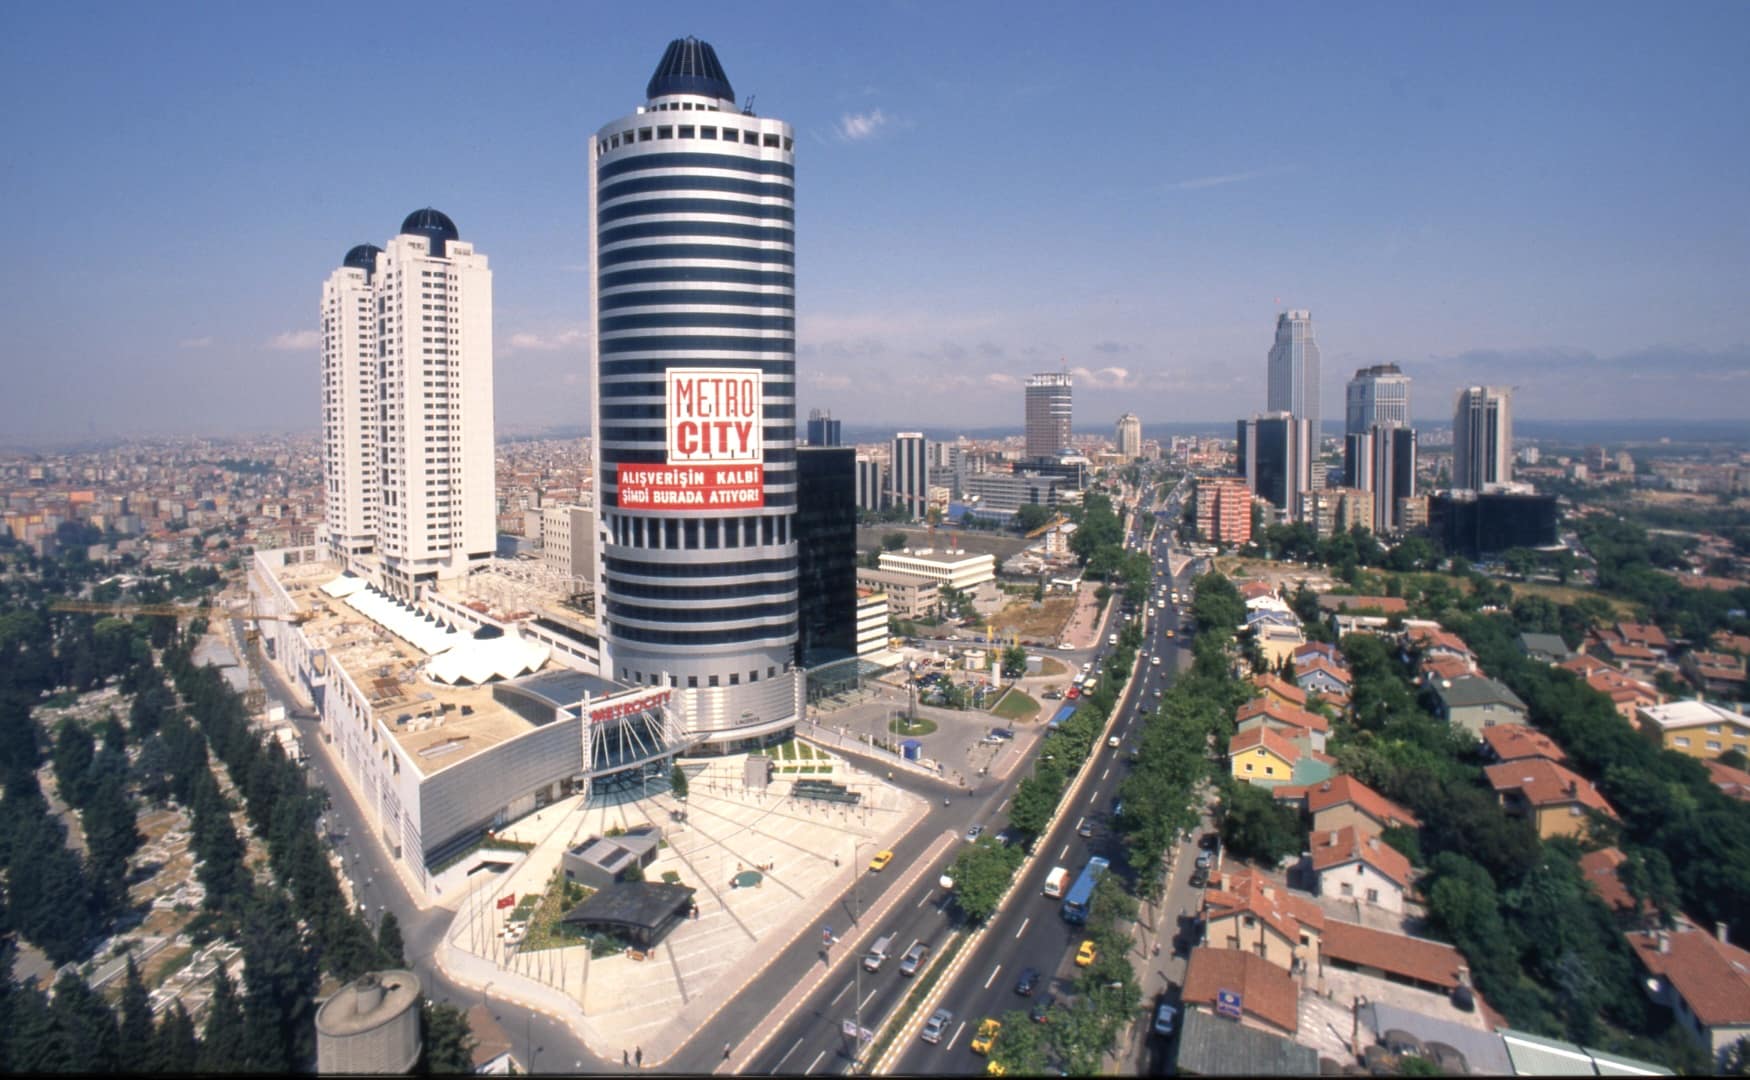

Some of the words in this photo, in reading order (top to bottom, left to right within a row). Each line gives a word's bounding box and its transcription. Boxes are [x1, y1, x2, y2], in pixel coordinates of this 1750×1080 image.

[676, 378, 753, 417] METRO
[677, 421, 752, 454] CITY
[622, 469, 704, 488] ALIŞVERİŞİN
[717, 469, 758, 485] KALBİ
[622, 488, 649, 504] ŞİMDİ
[654, 489, 704, 503] BURADA
[710, 489, 758, 503] ATIYOR!
[591, 691, 671, 722] METROCITY
